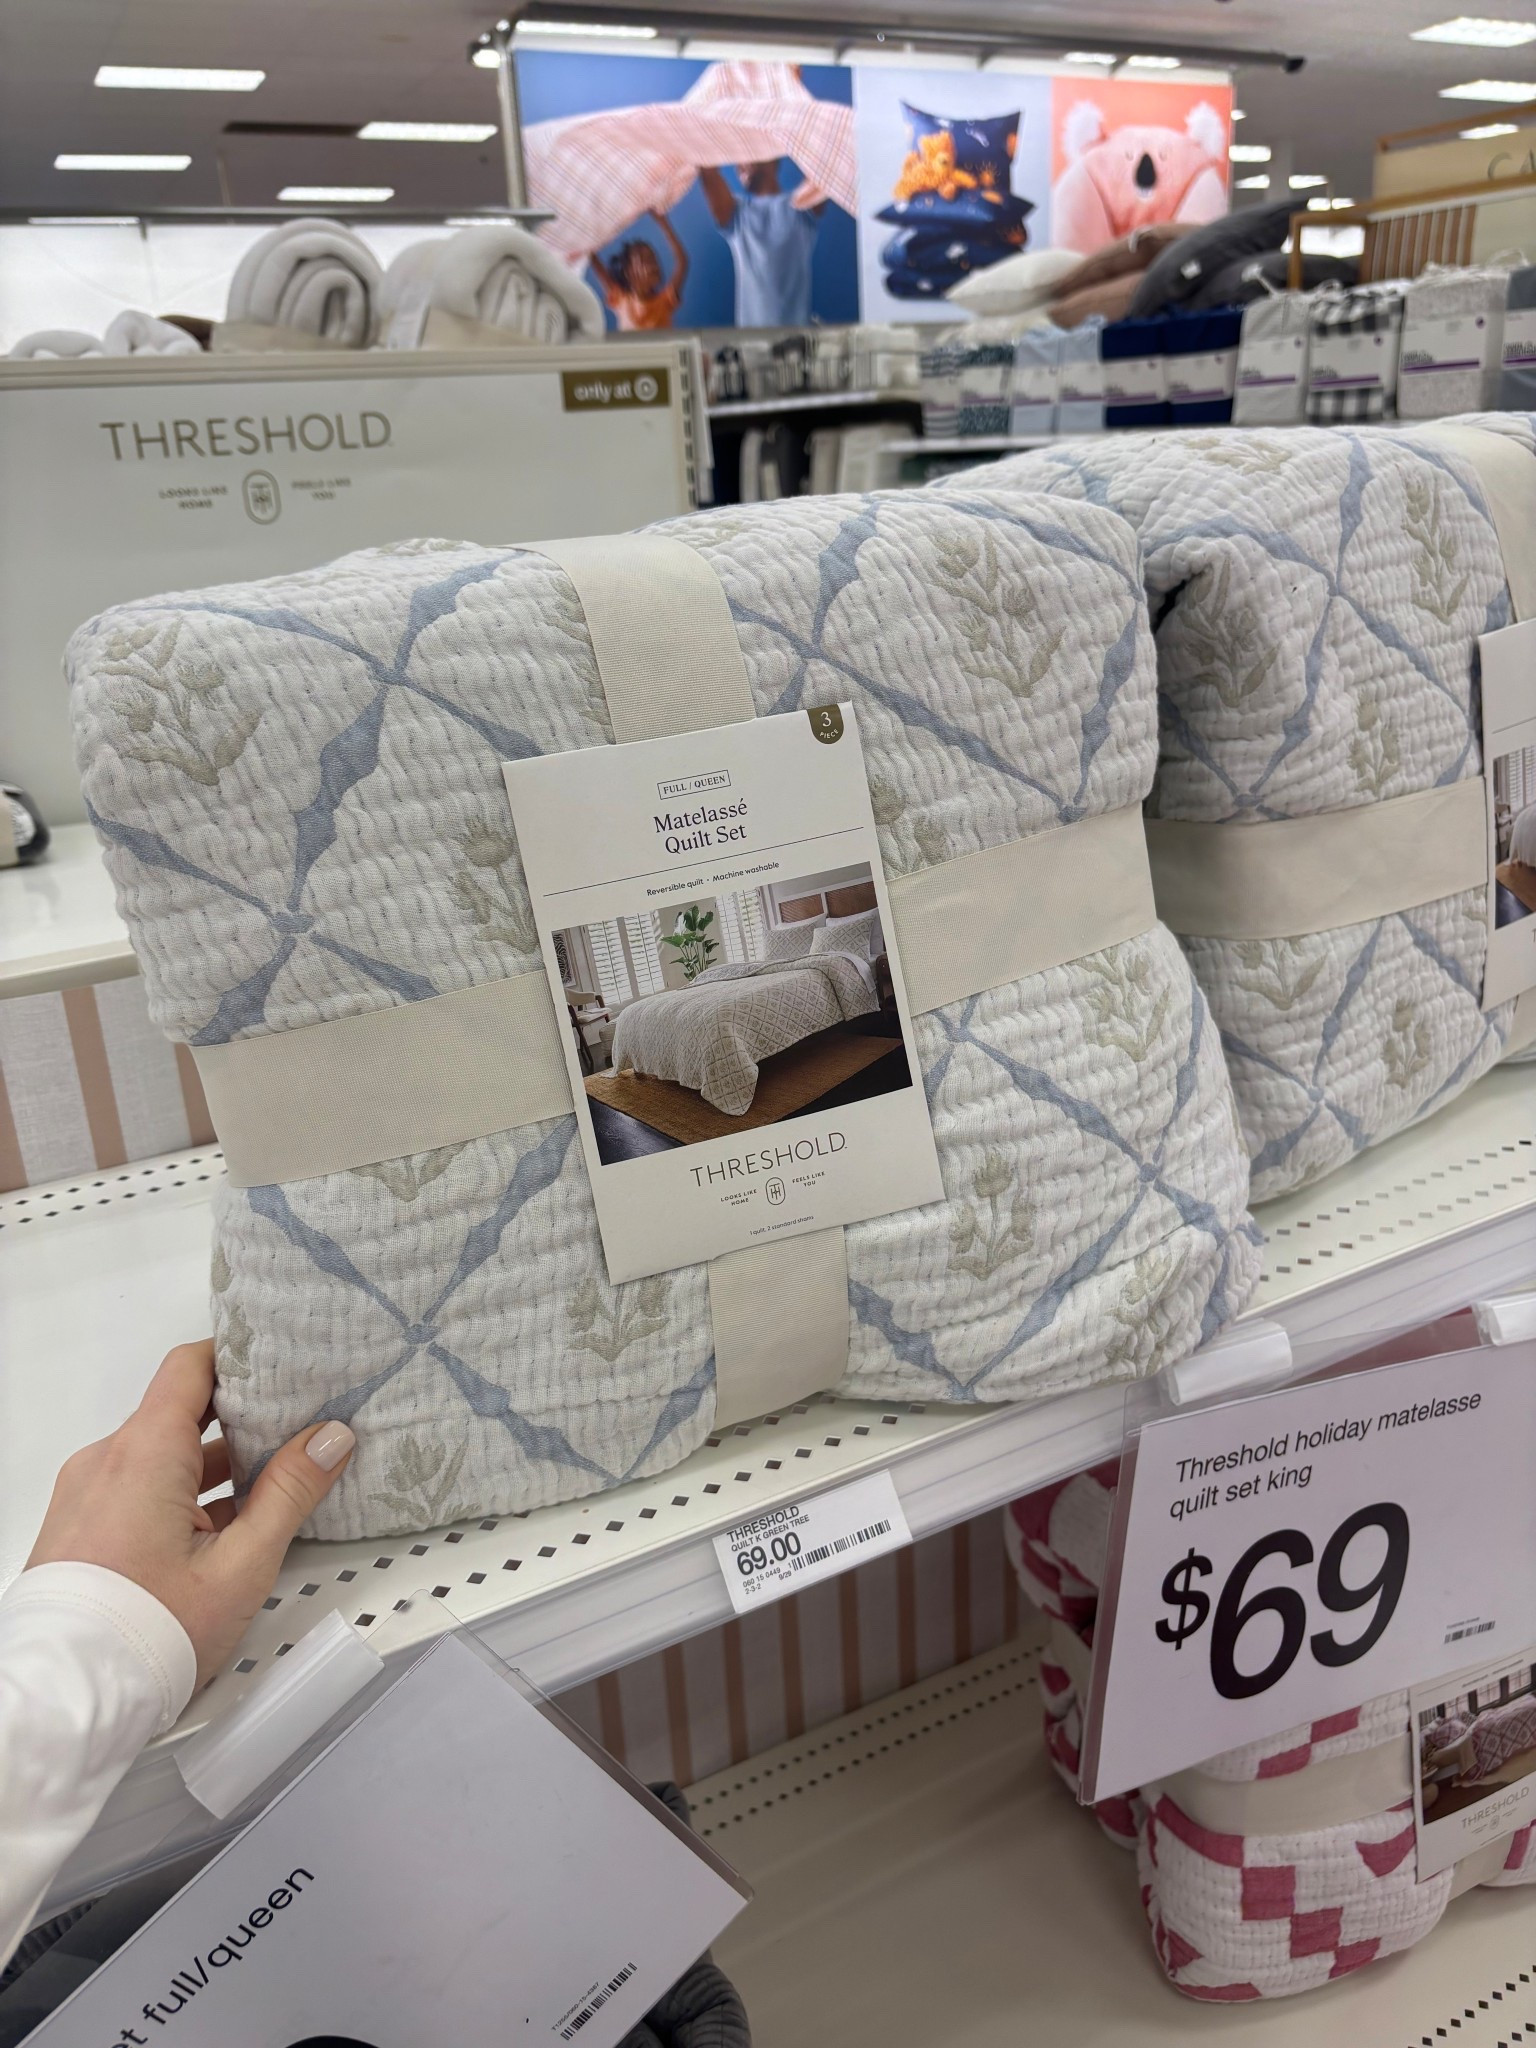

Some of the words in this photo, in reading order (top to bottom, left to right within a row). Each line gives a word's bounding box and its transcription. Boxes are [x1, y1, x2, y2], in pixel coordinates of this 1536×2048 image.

[613, 381, 633, 399] at
[100, 410, 392, 461] THRESHOLD
[819, 728, 840, 739] PIECE
[820, 711, 832, 727] 3
[663, 783, 687, 795] FULL
[694, 775, 726, 788] QUEEN
[653, 798, 748, 834] Matelassé
[665, 830, 713, 854] Quilt
[716, 824, 748, 844] Set
[646, 881, 686, 897] Reversible
[686, 878, 704, 889] quilt
[712, 870, 744, 883] Machine
[745, 861, 780, 874] washable
[690, 1132, 847, 1187] THRESHOLD
[792, 1174, 811, 1184] FEELS
[811, 1170, 826, 1179] LIKE
[720, 1192, 743, 1203] LOOKS
[743, 1188, 758, 1198] LIKE
[731, 1197, 750, 1206] HOME
[803, 1180, 817, 1188] YOU
[1176, 1433, 1289, 1483] Threshold
[1295, 1416, 1373, 1453] holiday
[1377, 1393, 1482, 1432] matelasse
[1170, 1486, 1219, 1521] quilt
[1225, 1475, 1261, 1502] set
[1266, 1464, 1313, 1489] king
[727, 1506, 800, 1543] THRESHOLD
[731, 1537, 754, 1552] QUILT
[755, 1533, 762, 1543] K
[762, 1523, 790, 1539] GREEN
[789, 1514, 810, 1528] TREE
[737, 1532, 802, 1576] 69.00
[1155, 1502, 1410, 1700] $69
[1462, 1786, 1530, 1830] THRESHOLD
[142, 1867, 315, 2026] full/queen
